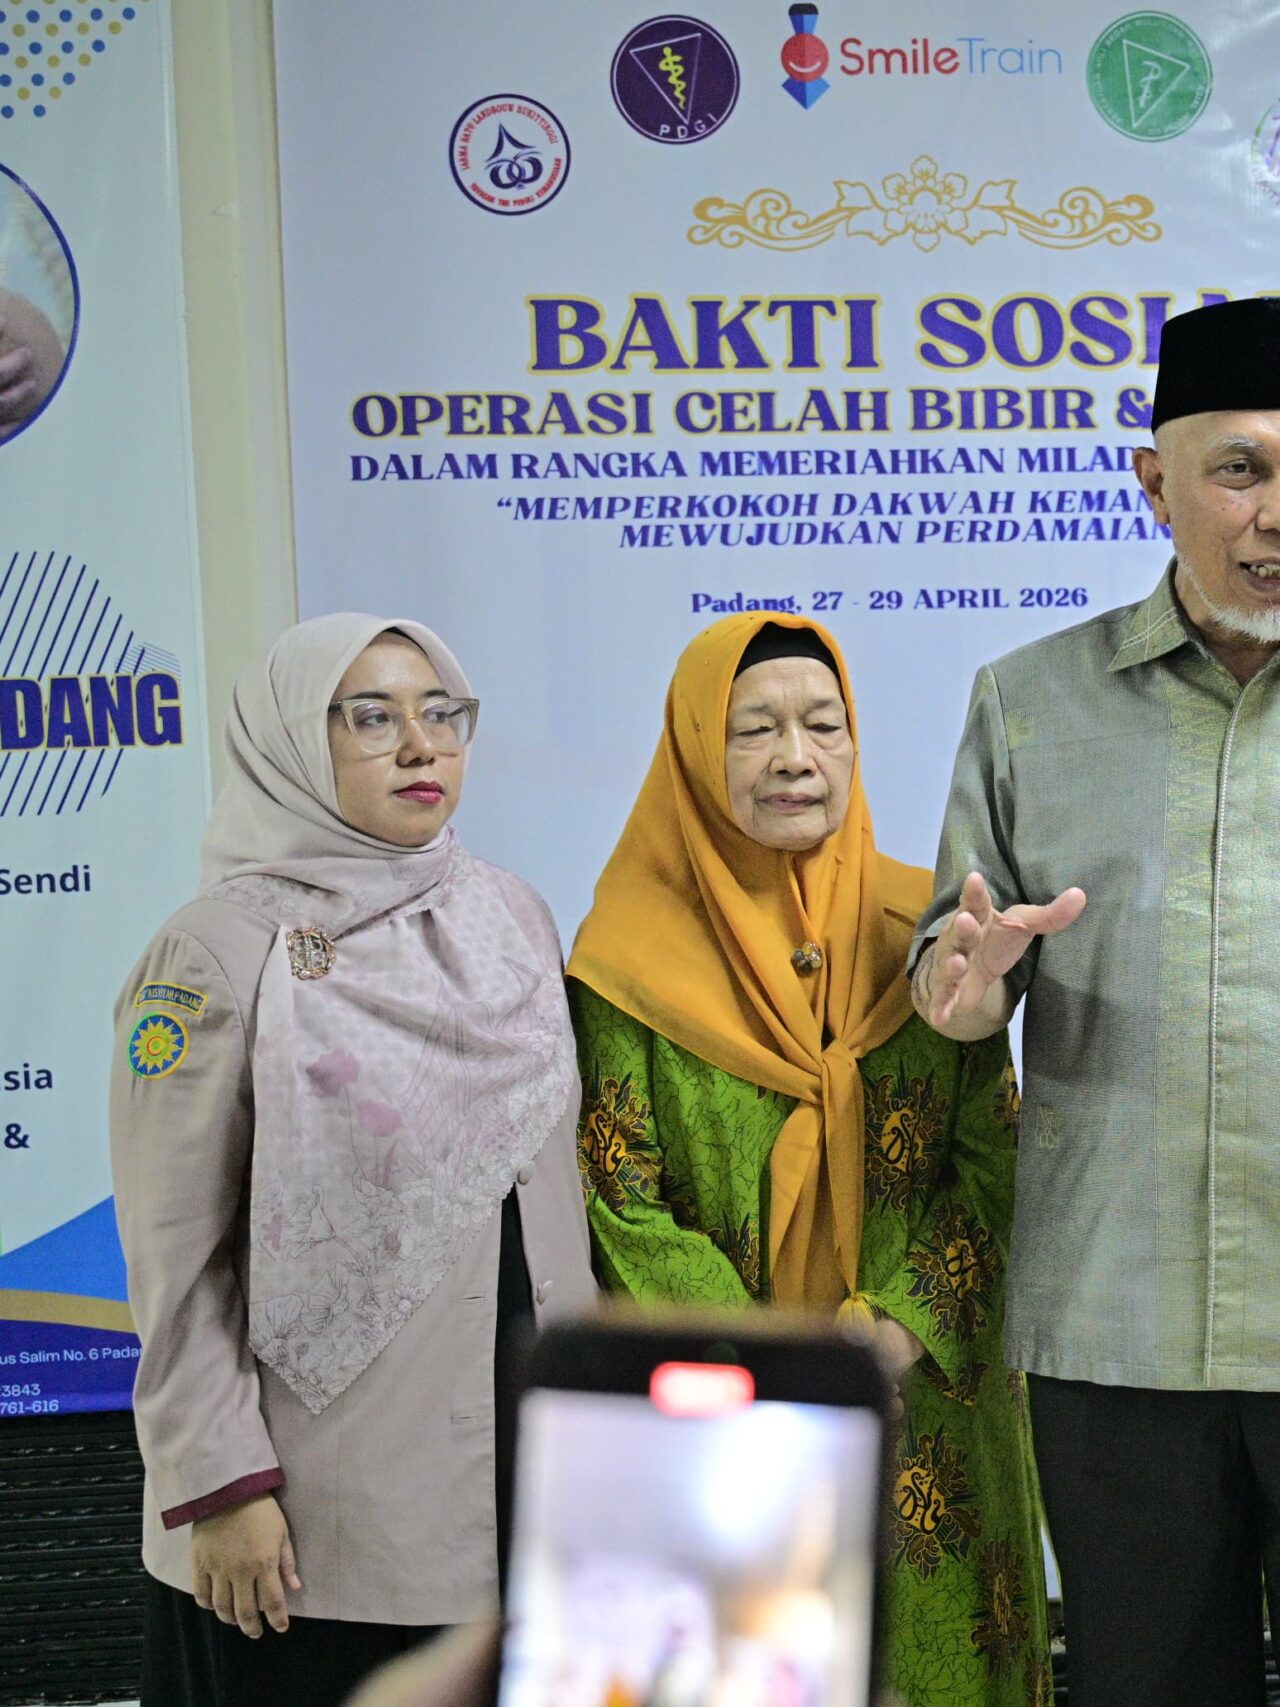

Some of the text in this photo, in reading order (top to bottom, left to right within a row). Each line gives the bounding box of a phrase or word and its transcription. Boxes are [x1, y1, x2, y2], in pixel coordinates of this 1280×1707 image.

[840, 37, 1062, 76] SmileTrain
[658, 112, 718, 139] PDGI
[528, 295, 879, 373] BAKTI
[350, 390, 654, 438] OPERASI
[674, 388, 891, 434] CELAH
[909, 386, 1098, 432] BIBIR
[1115, 386, 1154, 430] &
[350, 452, 498, 481] DALAM
[511, 450, 688, 479] RANGKA
[700, 447, 1005, 477] MEMERIAHKAN
[1018, 445, 1137, 473] MILAD
[832, 490, 1018, 516] DAKWAH
[1028, 488, 1154, 514] KEMAN
[618, 520, 903, 548] MEWUJUDKAN
[691, 592, 802, 614] Padang,
[812, 591, 844, 610] 27
[868, 590, 904, 610] 29
[912, 588, 1009, 610] APRIL
[1019, 587, 1089, 608] 2026
[0, 864, 91, 895] Sendi
[3, 1062, 53, 1091] sia
[3, 1122, 30, 1150] &
[20, 1349, 60, 1365] Salim
[63, 1347, 87, 1361] No.
[89, 1347, 99, 1360] 6
[102, 1345, 143, 1359] Pada
[1, 1383, 41, 1398] 3843
